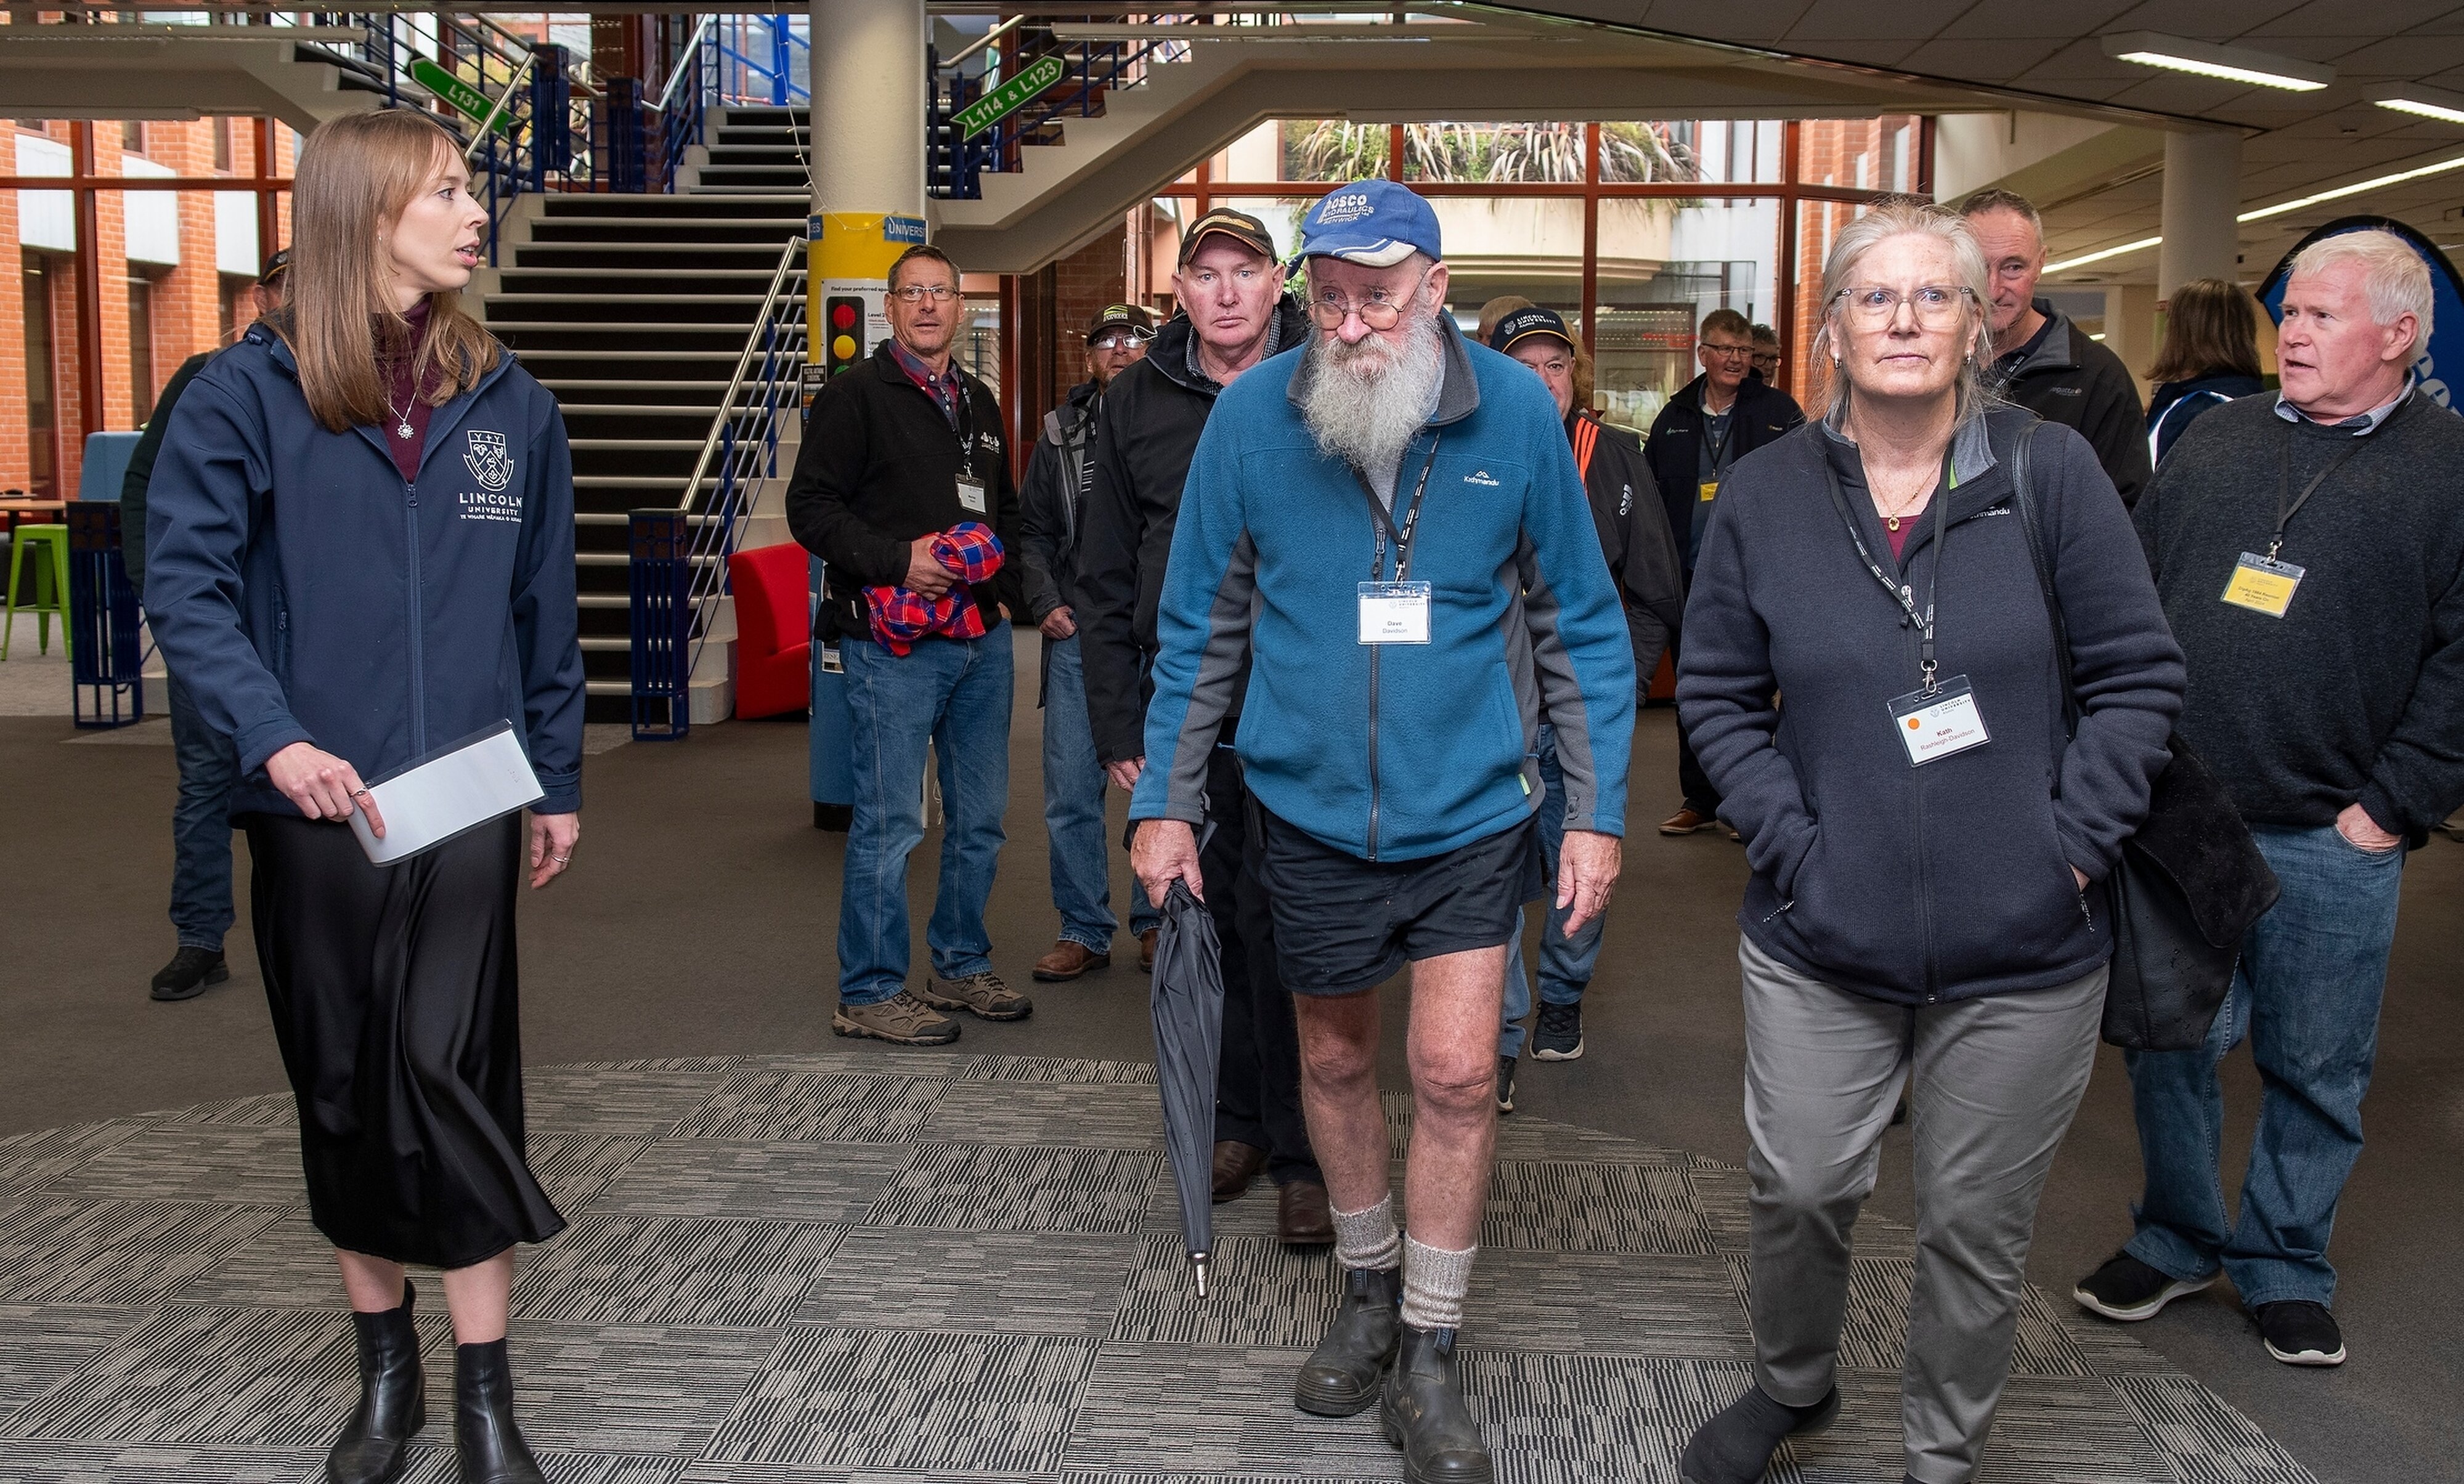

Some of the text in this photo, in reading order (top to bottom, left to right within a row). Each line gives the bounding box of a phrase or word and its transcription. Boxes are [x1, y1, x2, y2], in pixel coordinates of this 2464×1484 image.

[448, 84, 481, 111] L131
[966, 62, 1057, 128] L114 & L123
[459, 492, 522, 508] LINCOLN
[468, 506, 518, 516] UNIVERSITY
[1920, 728, 1975, 751] Rashleigh-Davidson
[1936, 727, 1953, 737] Kath
